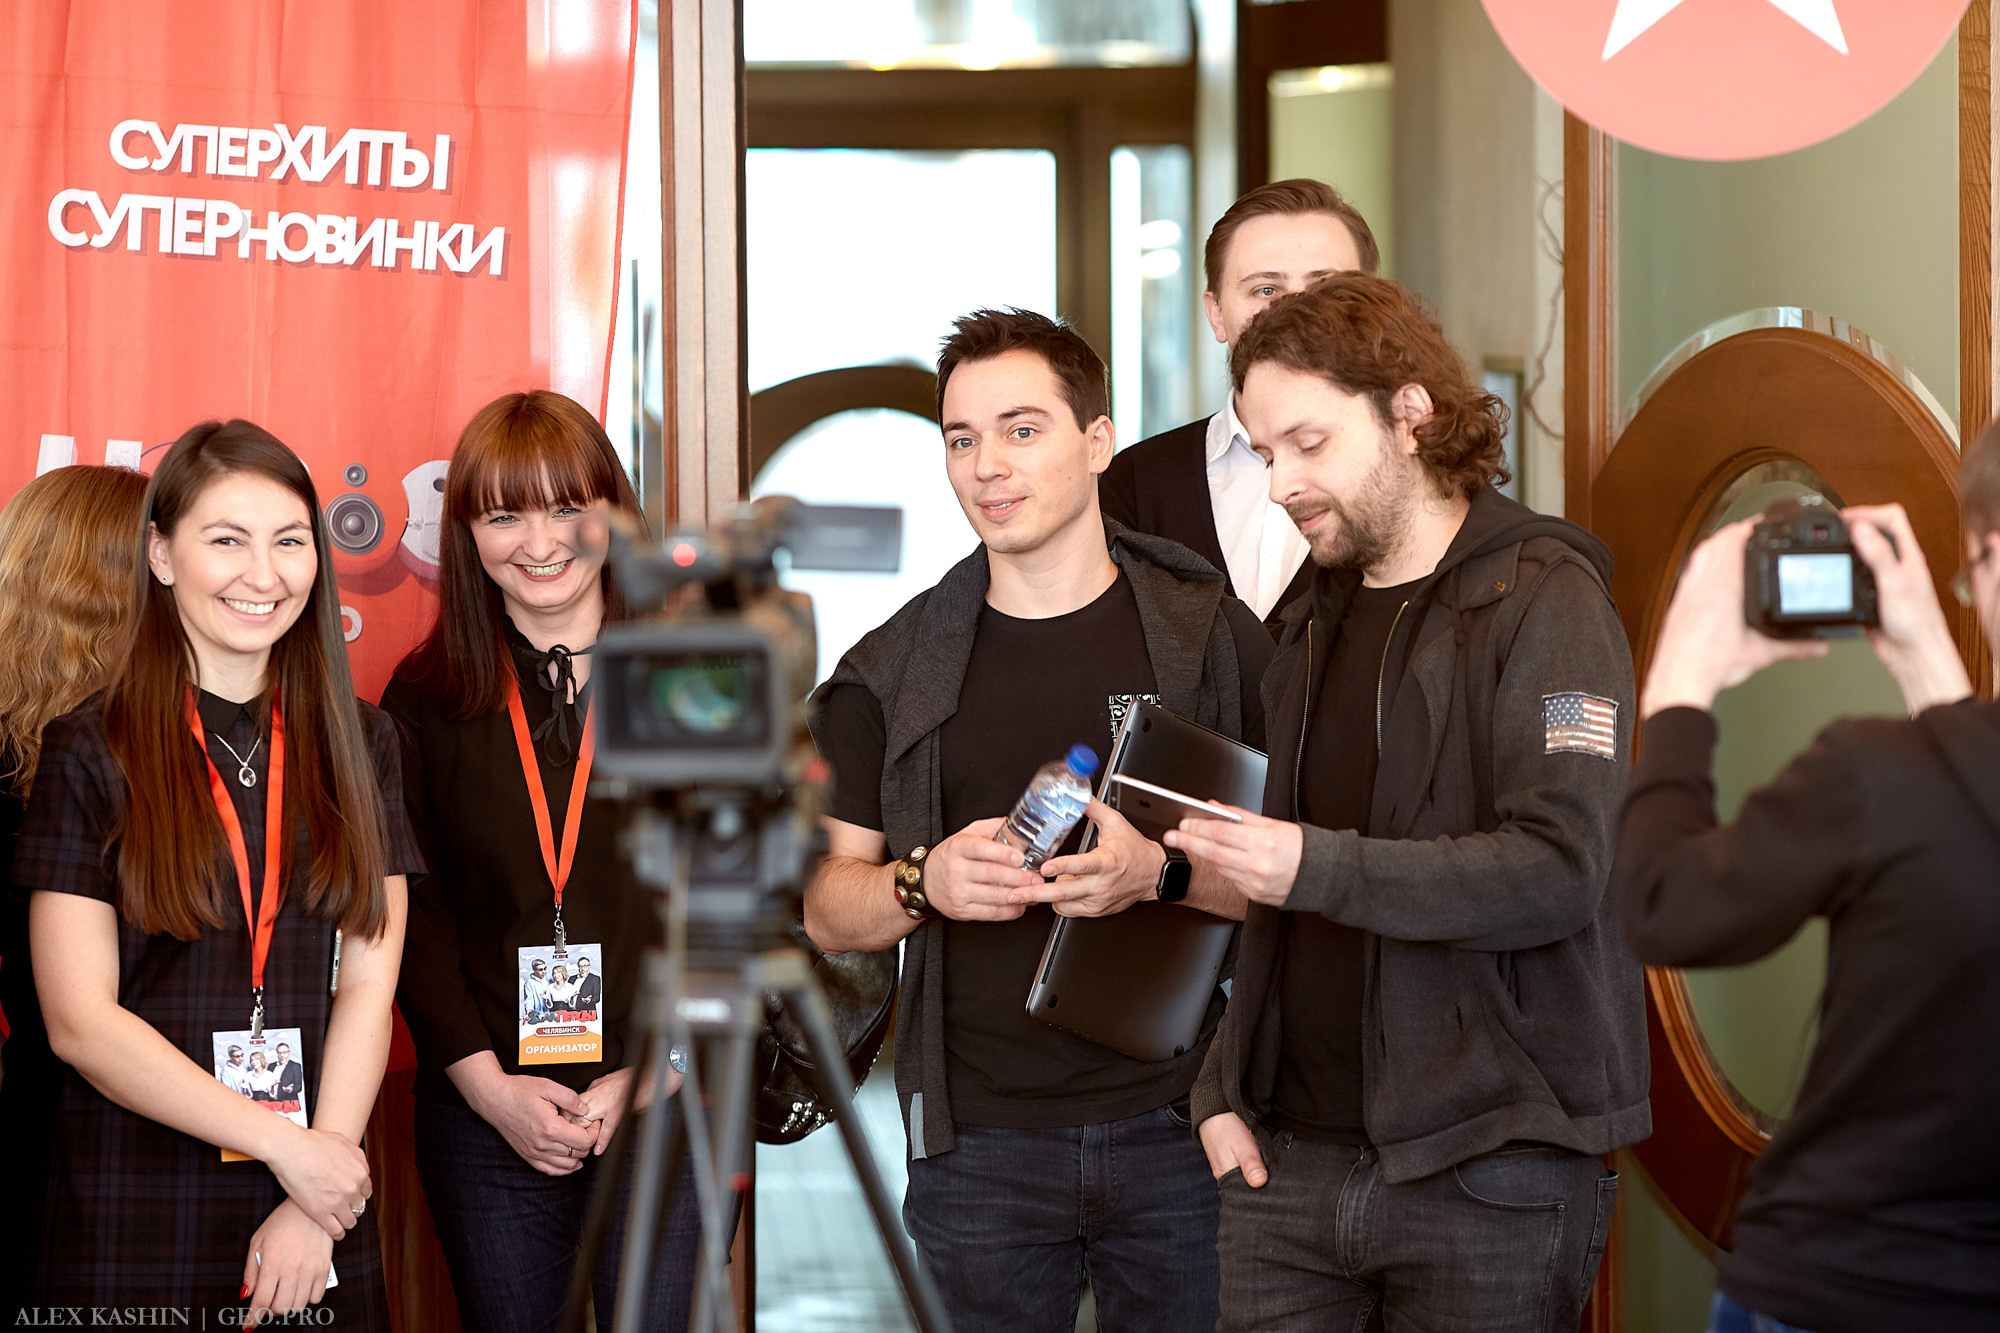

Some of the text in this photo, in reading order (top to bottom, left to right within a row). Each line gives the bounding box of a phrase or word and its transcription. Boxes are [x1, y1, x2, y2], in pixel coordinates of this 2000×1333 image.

[109, 119, 451, 191] СУПЕРХИТЫ
[47, 188, 506, 276] СУПЕРНОВИНКИ
[525, 1042, 598, 1054] ОРГАНИЗАТОР
[542, 1026, 581, 1034] ЧЕЛЯБИНСК
